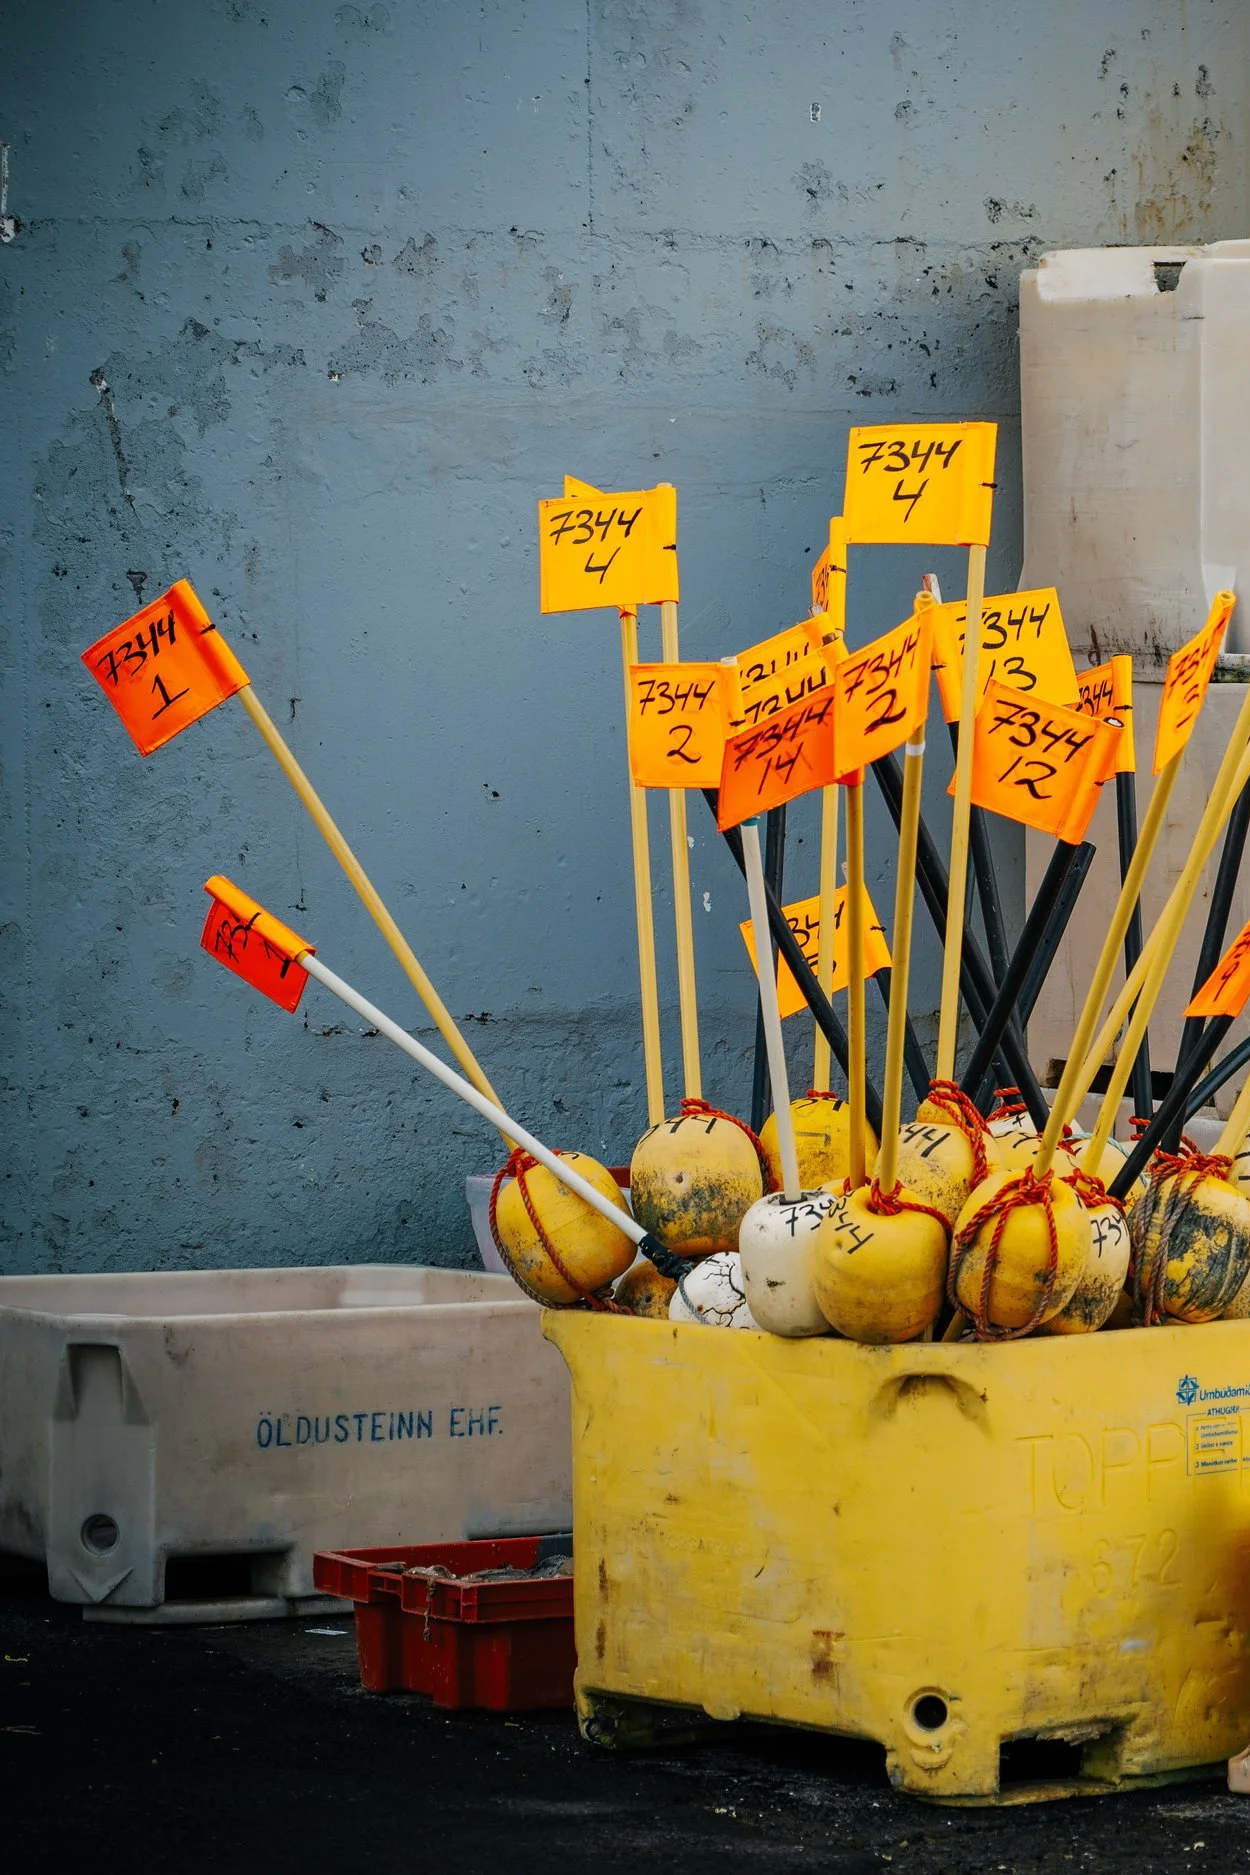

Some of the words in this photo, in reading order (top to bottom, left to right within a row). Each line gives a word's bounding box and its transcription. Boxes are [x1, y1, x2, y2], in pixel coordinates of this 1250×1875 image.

[858, 438, 963, 474] 7344
[892, 478, 929, 522] 4
[549, 507, 644, 545] 7344
[584, 547, 621, 584] 4
[97, 608, 177, 686] 7344
[843, 627, 921, 703] 7344
[151, 674, 190, 720] 1
[638, 680, 715, 716] 7344
[864, 688, 907, 736] 2
[667, 724, 702, 763] 2
[734, 696, 834, 772] 7344
[988, 700, 1094, 763] 7344
[757, 742, 803, 795] 14
[998, 756, 1058, 800] 12
[257, 1409, 434, 1449] ÖLDUSTEINN
[449, 1406, 504, 1438] EHF.
[1091, 1528, 1183, 1598] 672
